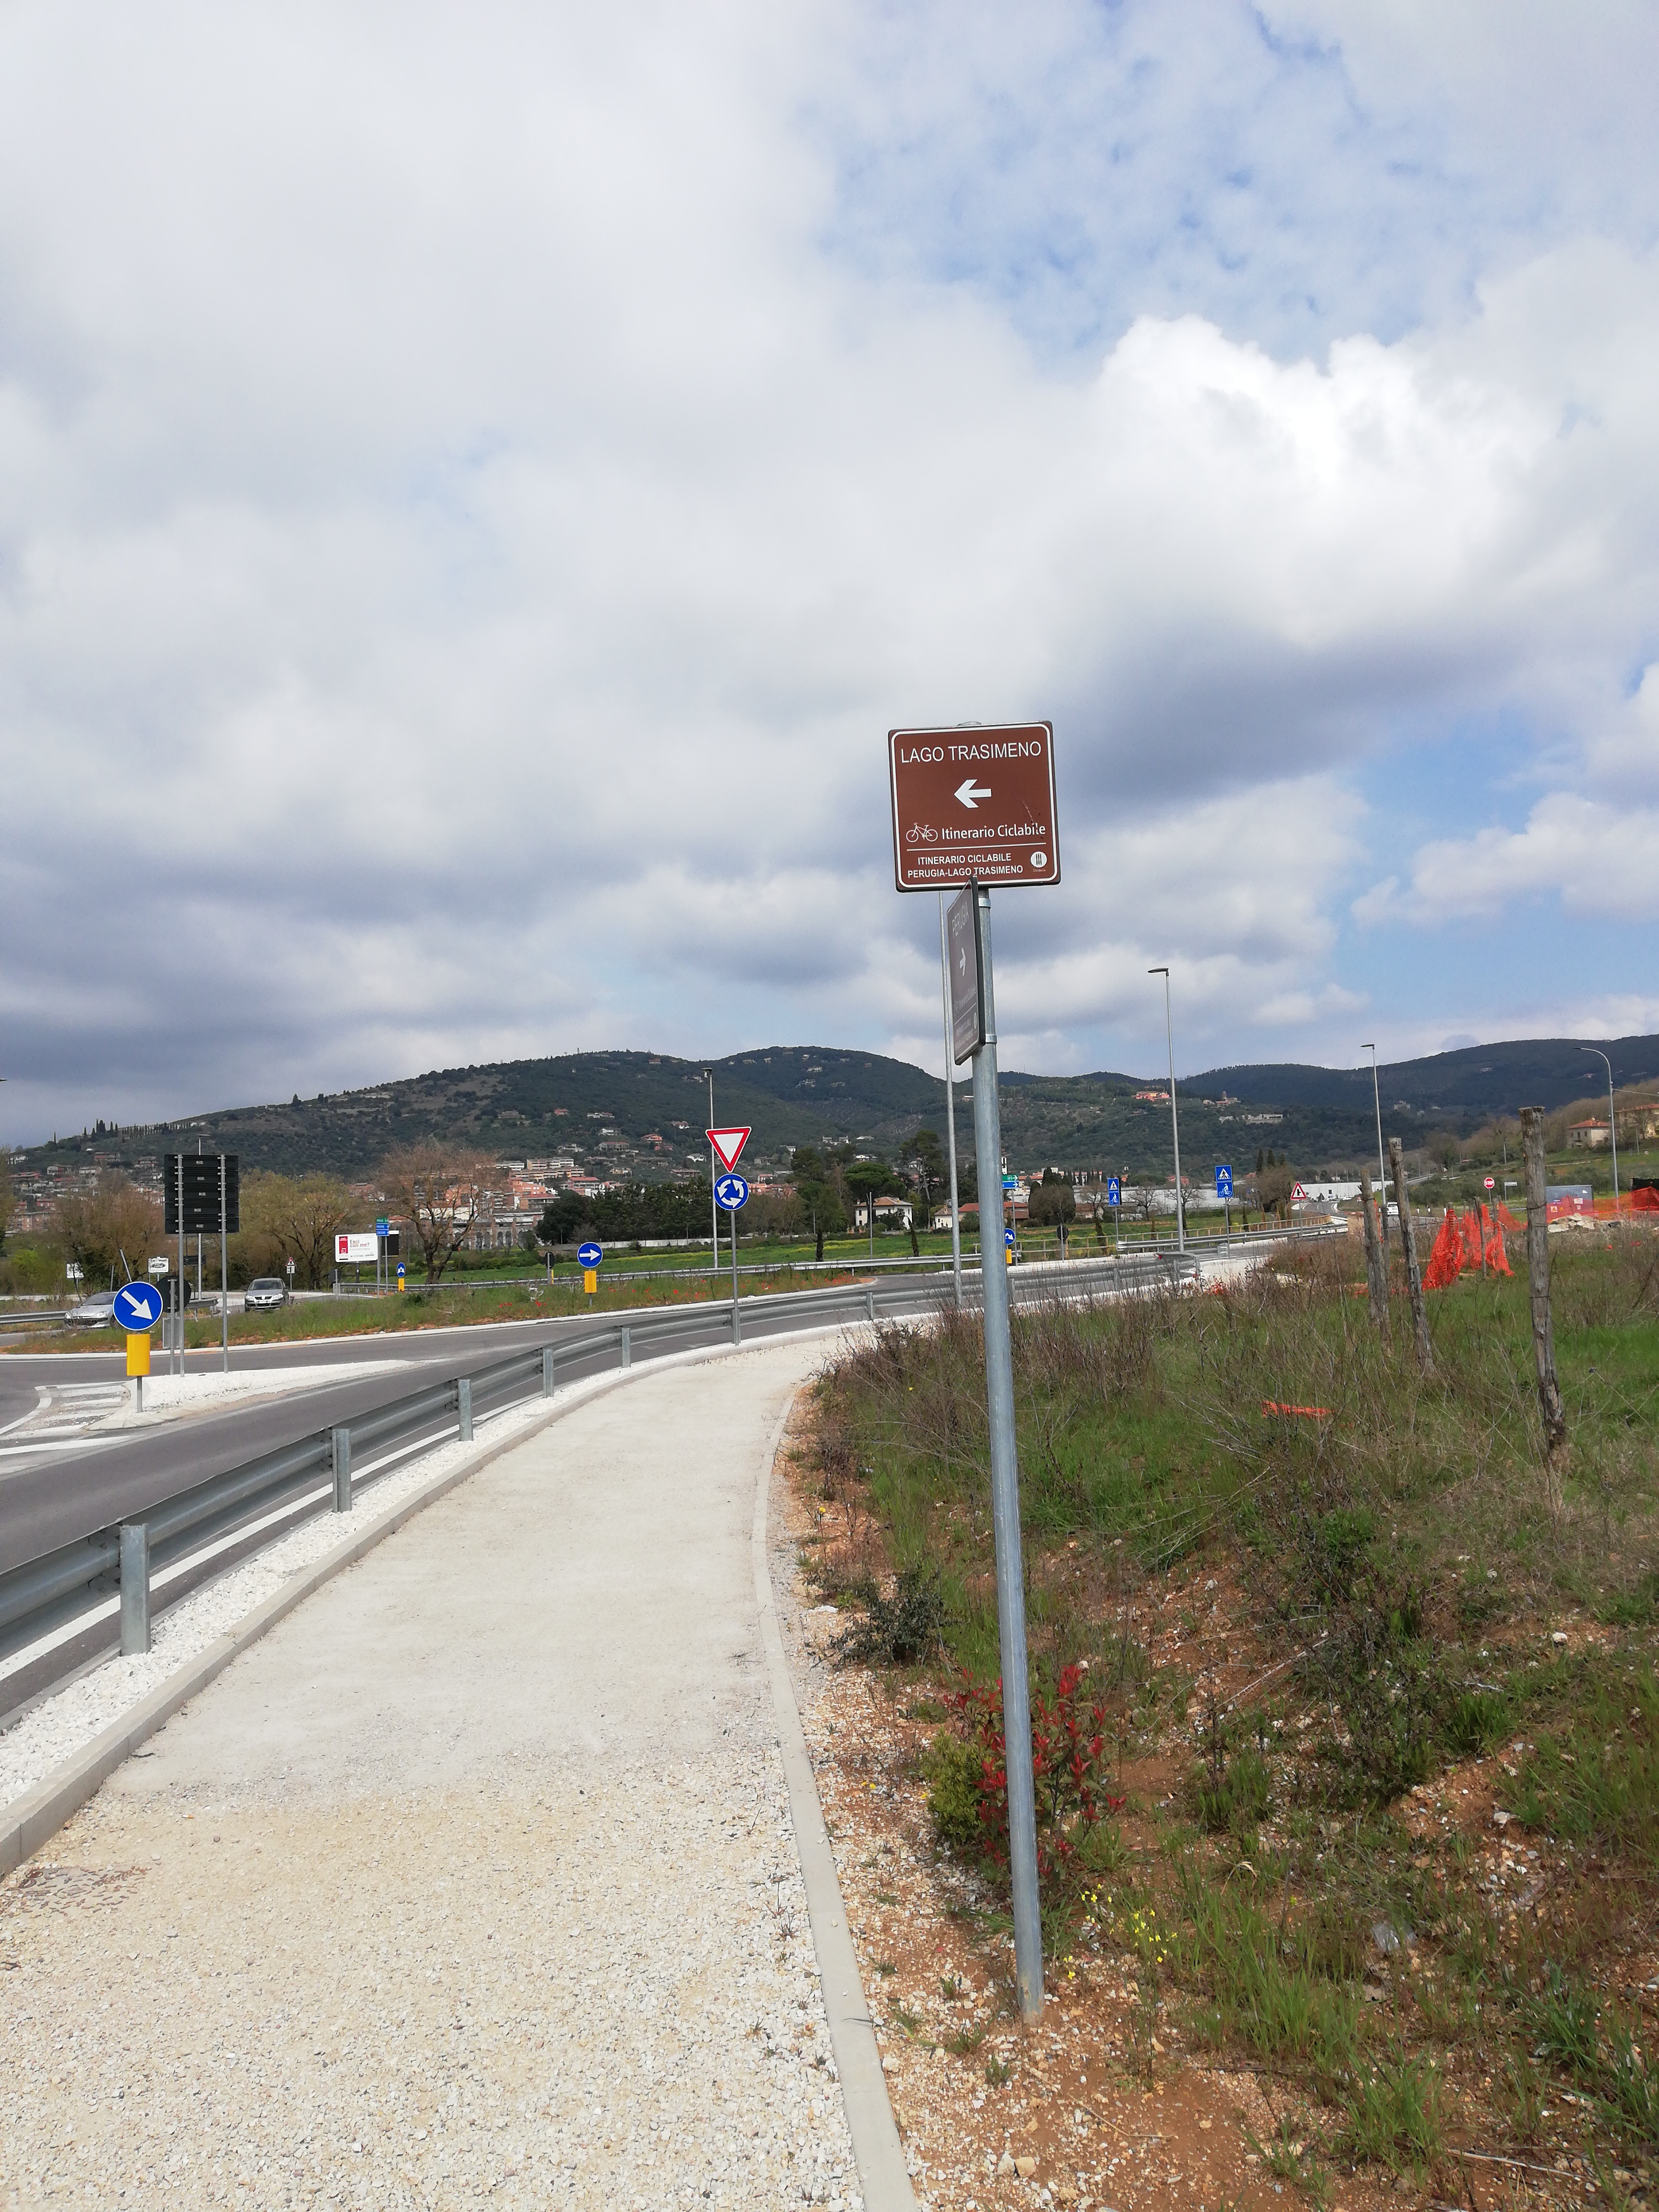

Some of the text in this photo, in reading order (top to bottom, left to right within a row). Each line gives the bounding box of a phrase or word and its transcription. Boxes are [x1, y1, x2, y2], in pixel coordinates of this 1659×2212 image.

[901, 741, 1042, 763] LAGO TRASIMENO
[942, 822, 1046, 840] Itinerario Ciclabile
[918, 853, 1011, 865] ITINERARIO CICLABILE
[908, 865, 1023, 878] PERUGIA-LAGO TRASIMENO
[952, 901, 970, 939] PERUGIA
